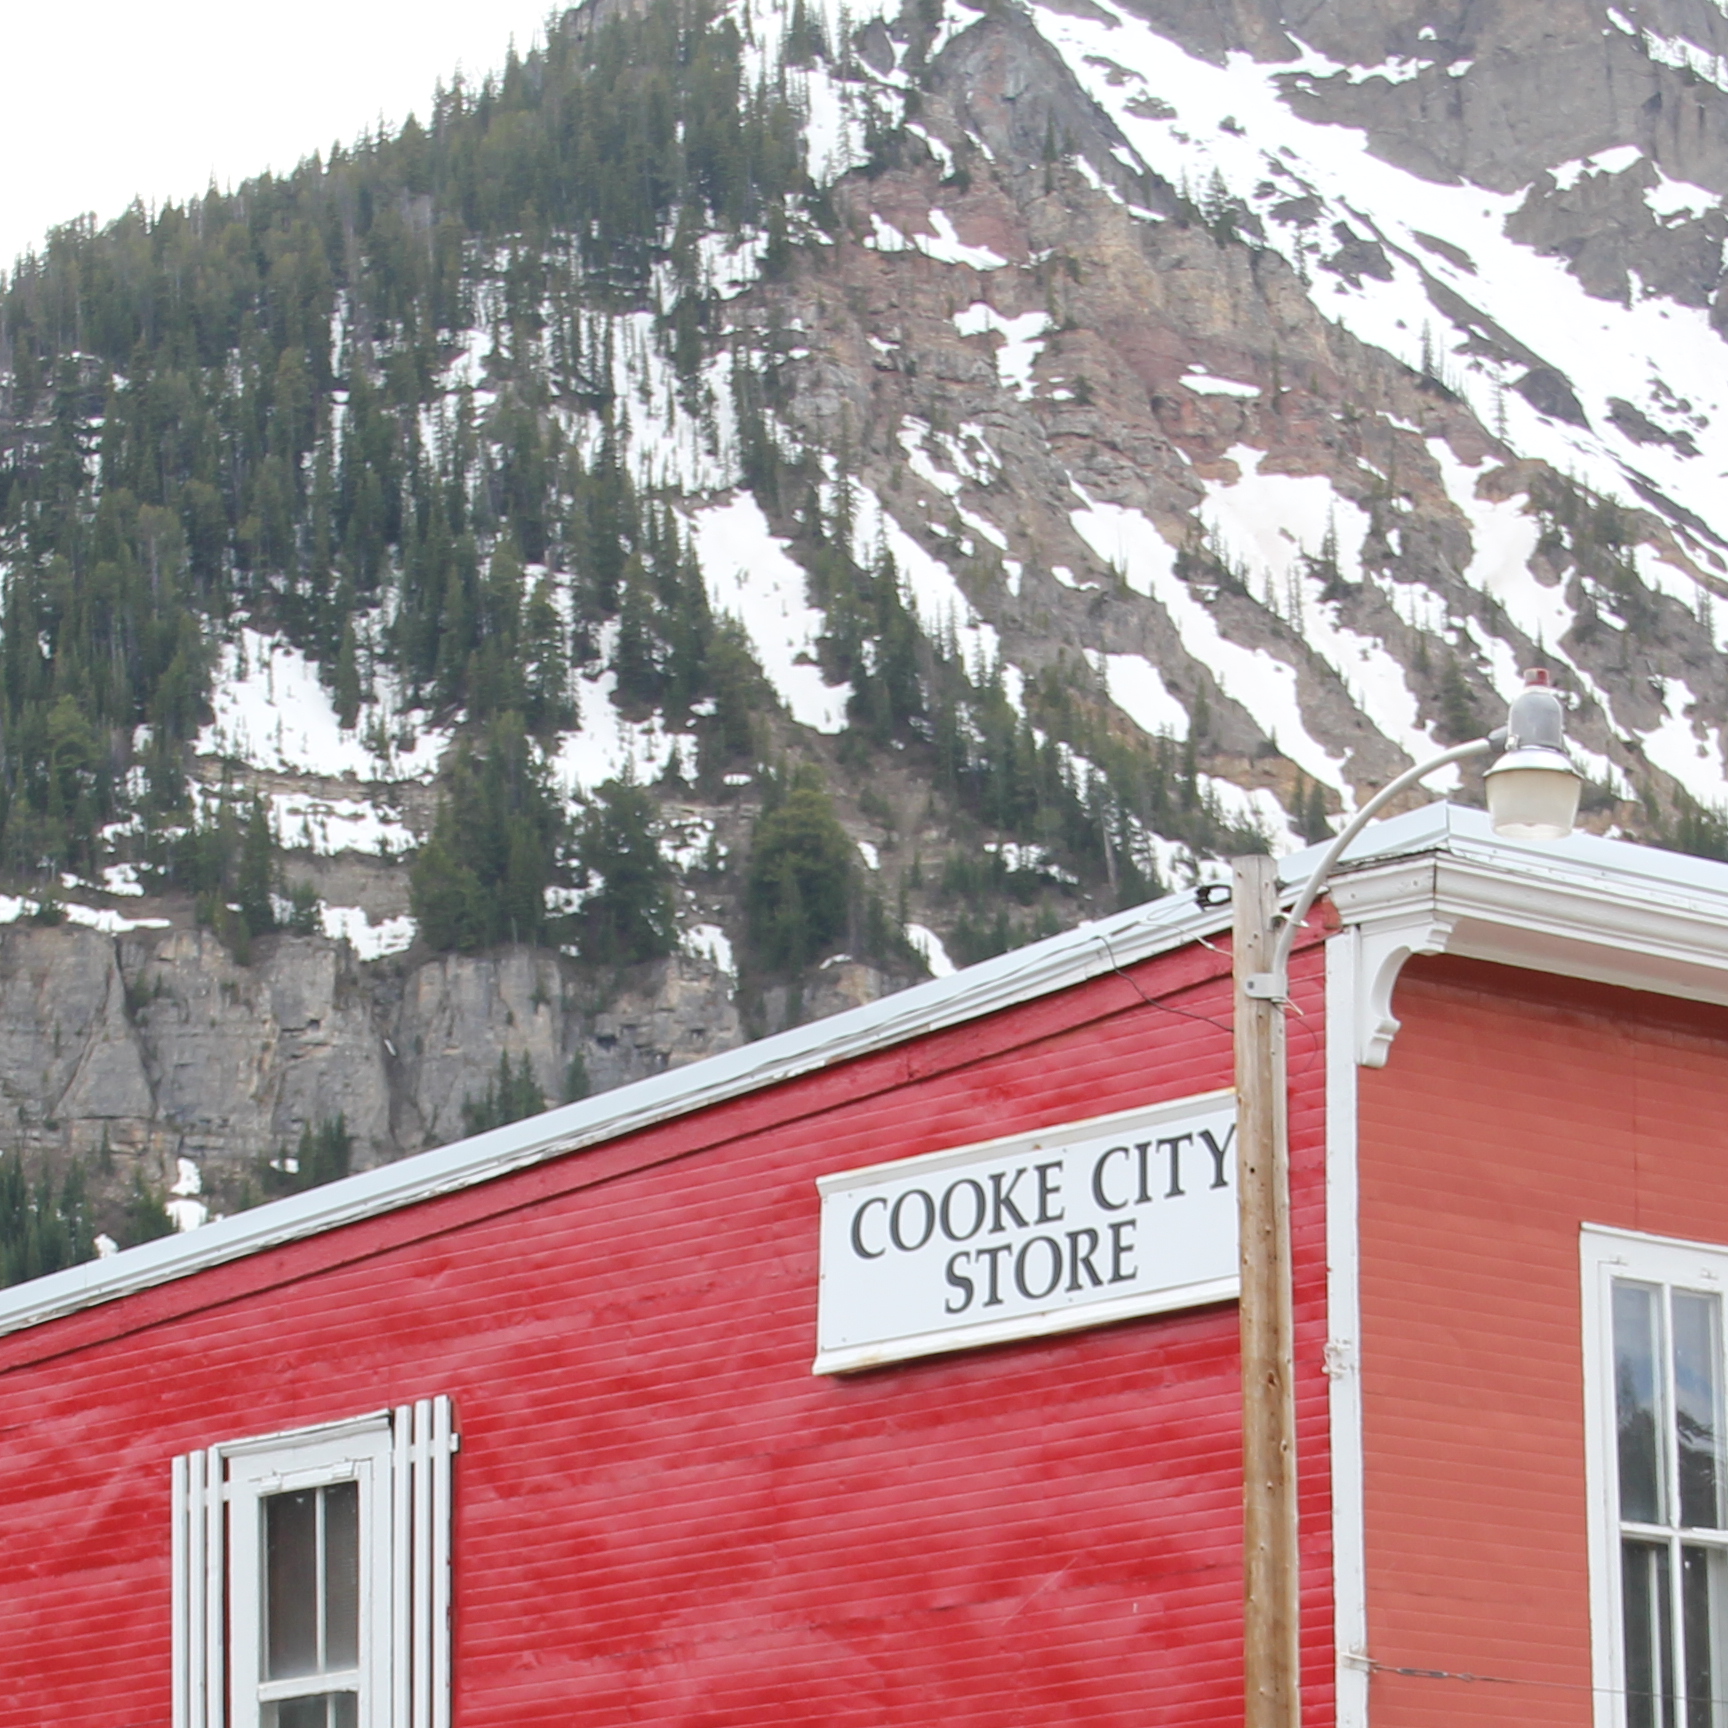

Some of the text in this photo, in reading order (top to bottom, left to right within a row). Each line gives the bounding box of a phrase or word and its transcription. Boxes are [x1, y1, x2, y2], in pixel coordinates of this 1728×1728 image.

[851, 1122, 1236, 1260] COOKE CITY
[944, 1219, 1138, 1315] STORE
